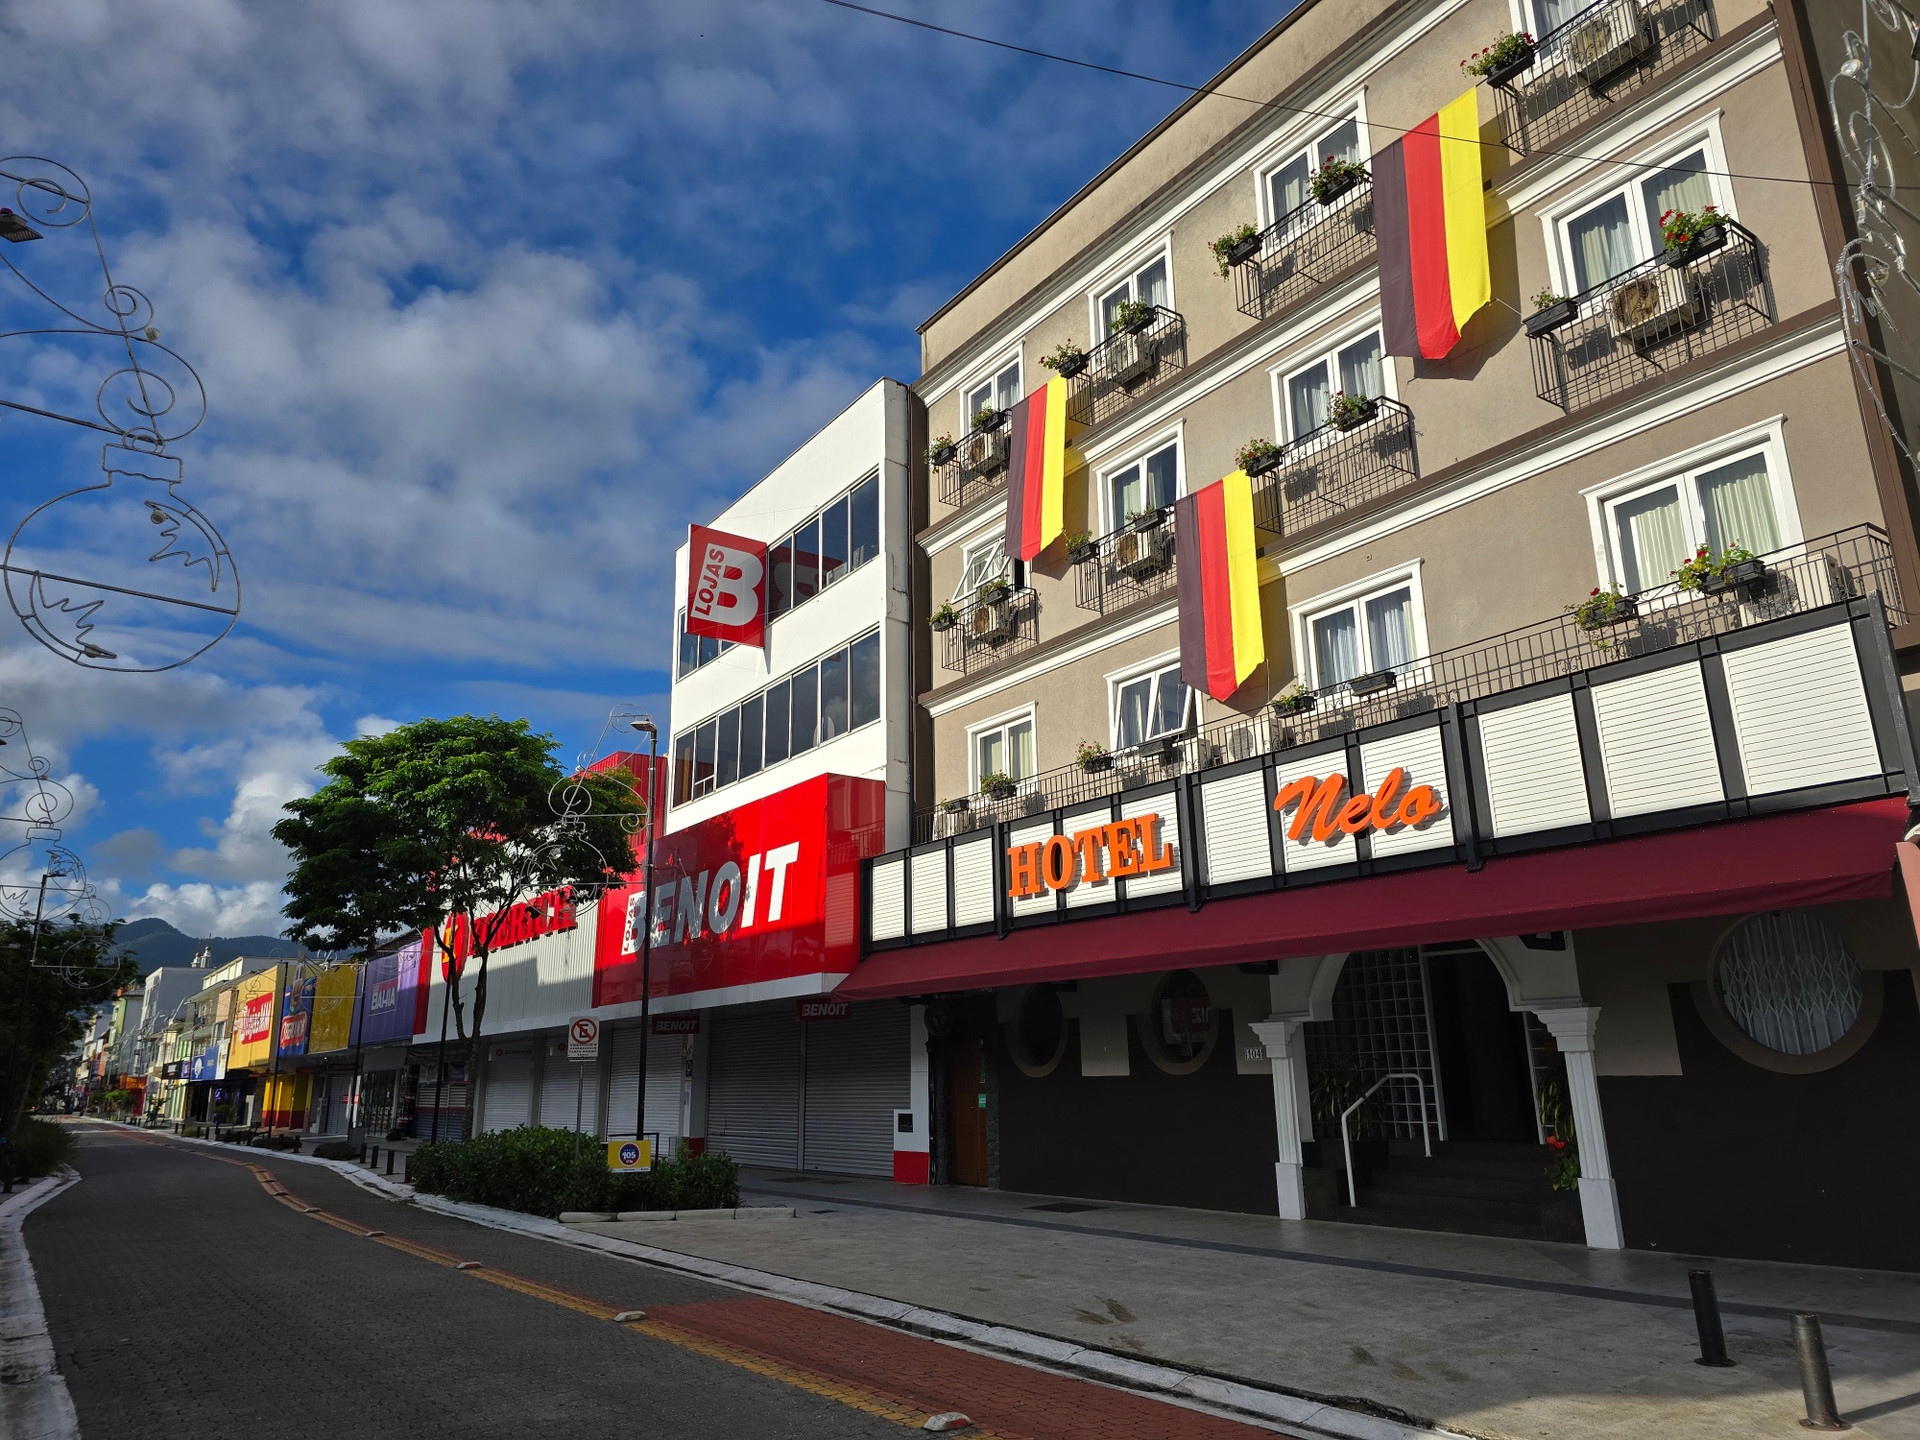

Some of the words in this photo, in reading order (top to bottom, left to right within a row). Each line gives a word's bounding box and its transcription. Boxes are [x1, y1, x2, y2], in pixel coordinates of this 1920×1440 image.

[690, 543, 763, 626] B
[694, 548, 725, 616] LOJAS
[1273, 767, 1443, 841] Nelo
[1007, 813, 1174, 897] HOTEL
[621, 841, 800, 956] BENOIT
[624, 897, 636, 952] LOJAS
[371, 987, 395, 1010] BAHIA
[655, 1019, 698, 1032] BENOIT
[802, 1003, 848, 1017] BENOIT
[622, 1151, 636, 1160] 105
